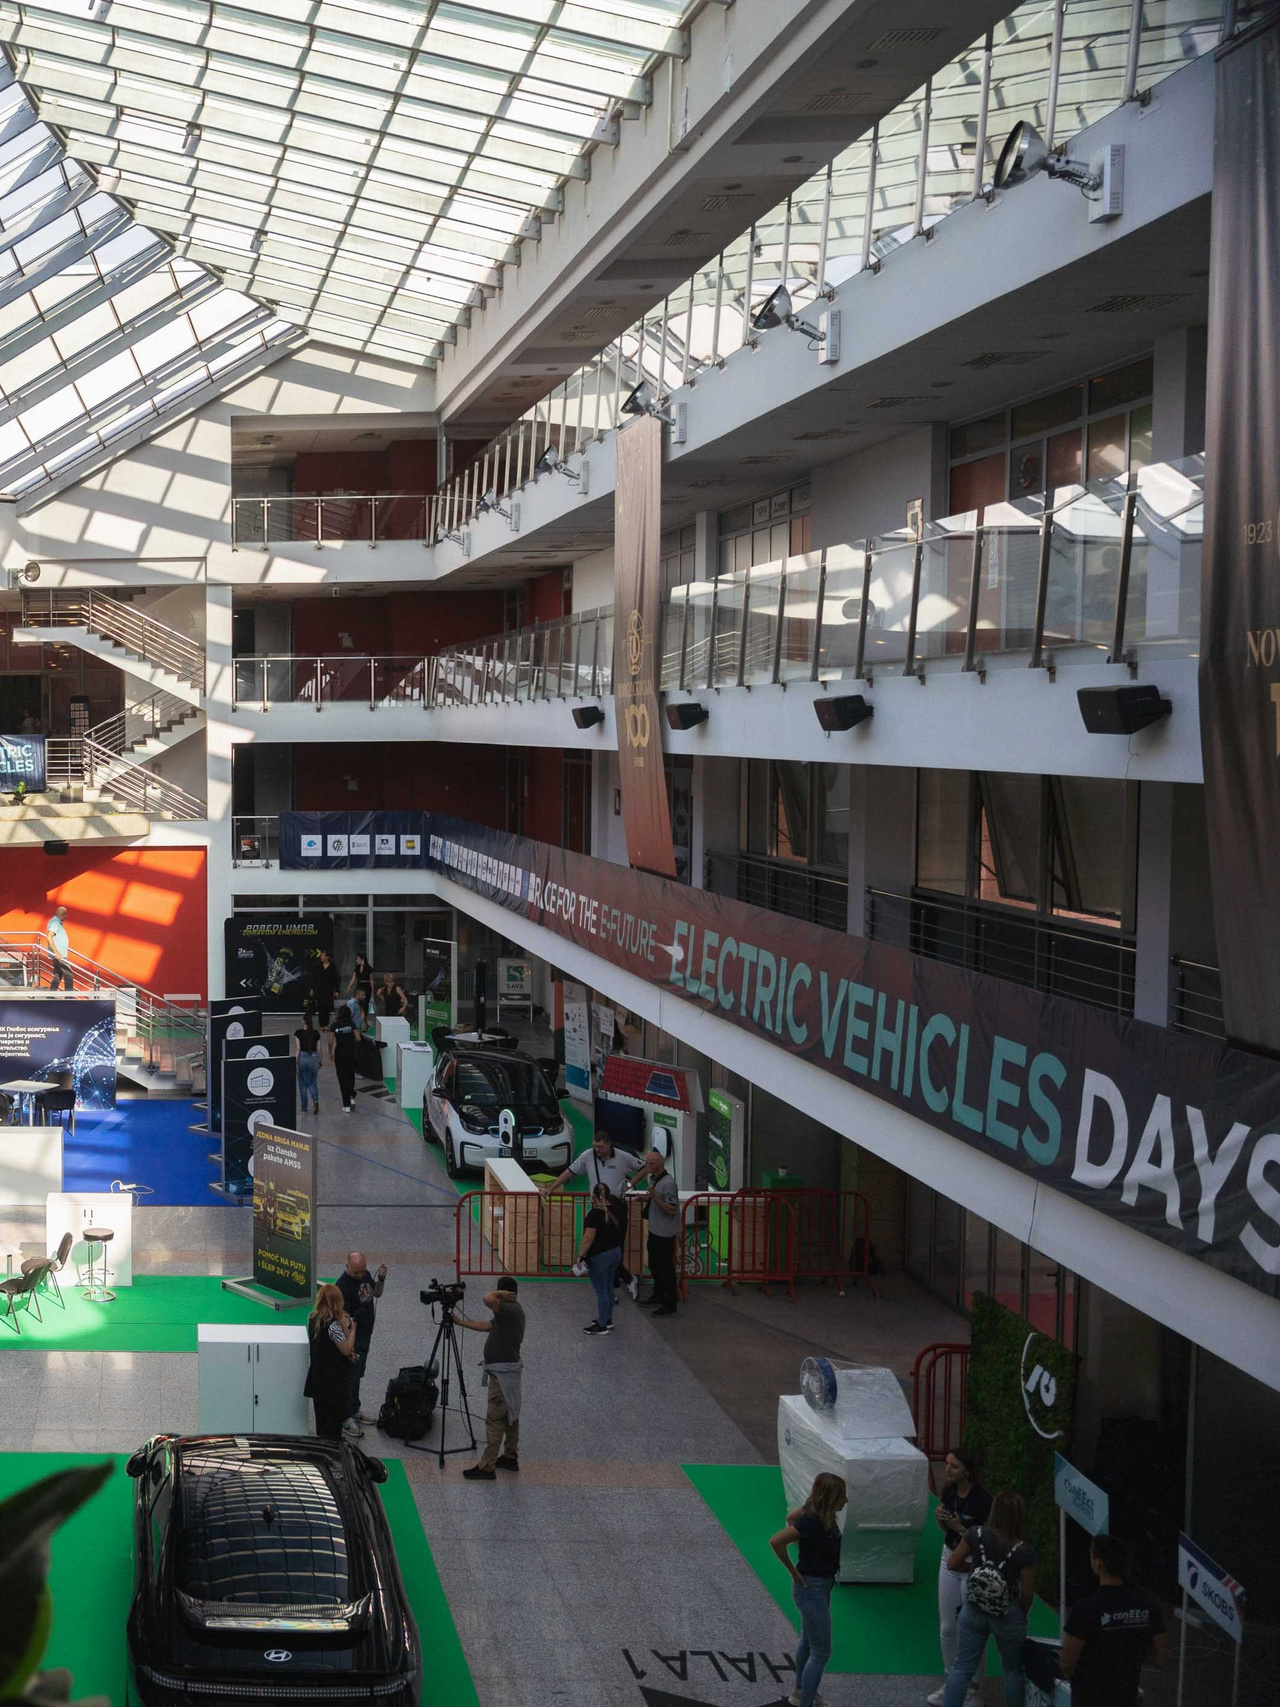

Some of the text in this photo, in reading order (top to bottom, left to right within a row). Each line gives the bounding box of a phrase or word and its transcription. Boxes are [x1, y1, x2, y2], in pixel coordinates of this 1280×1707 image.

[1244, 521, 1272, 545] 1923
[625, 703, 650, 748] 100
[557, 886, 576, 925] FOR
[578, 894, 598, 935] THE
[599, 904, 657, 963] E-FUTURE
[670, 919, 813, 1046] ELECTRIC
[818, 971, 1068, 1166] VEHICLES
[1071, 1067, 1280, 1276] DAYS
[256, 1130, 310, 1152] JEDNA BRIGA MANJE
[267, 1144, 297, 1159] uz članske
[263, 1152, 302, 1170] pakete AMSS
[258, 1249, 307, 1273] POMOĆ NA PUTU
[261, 1260, 276, 1272] ŠLEP
[276, 1266, 290, 1278] 24/7
[1202, 1582, 1235, 1622] SKOBS
[1112, 1609, 1150, 1620] conEEct
[621, 1648, 797, 1684] HALA 1
